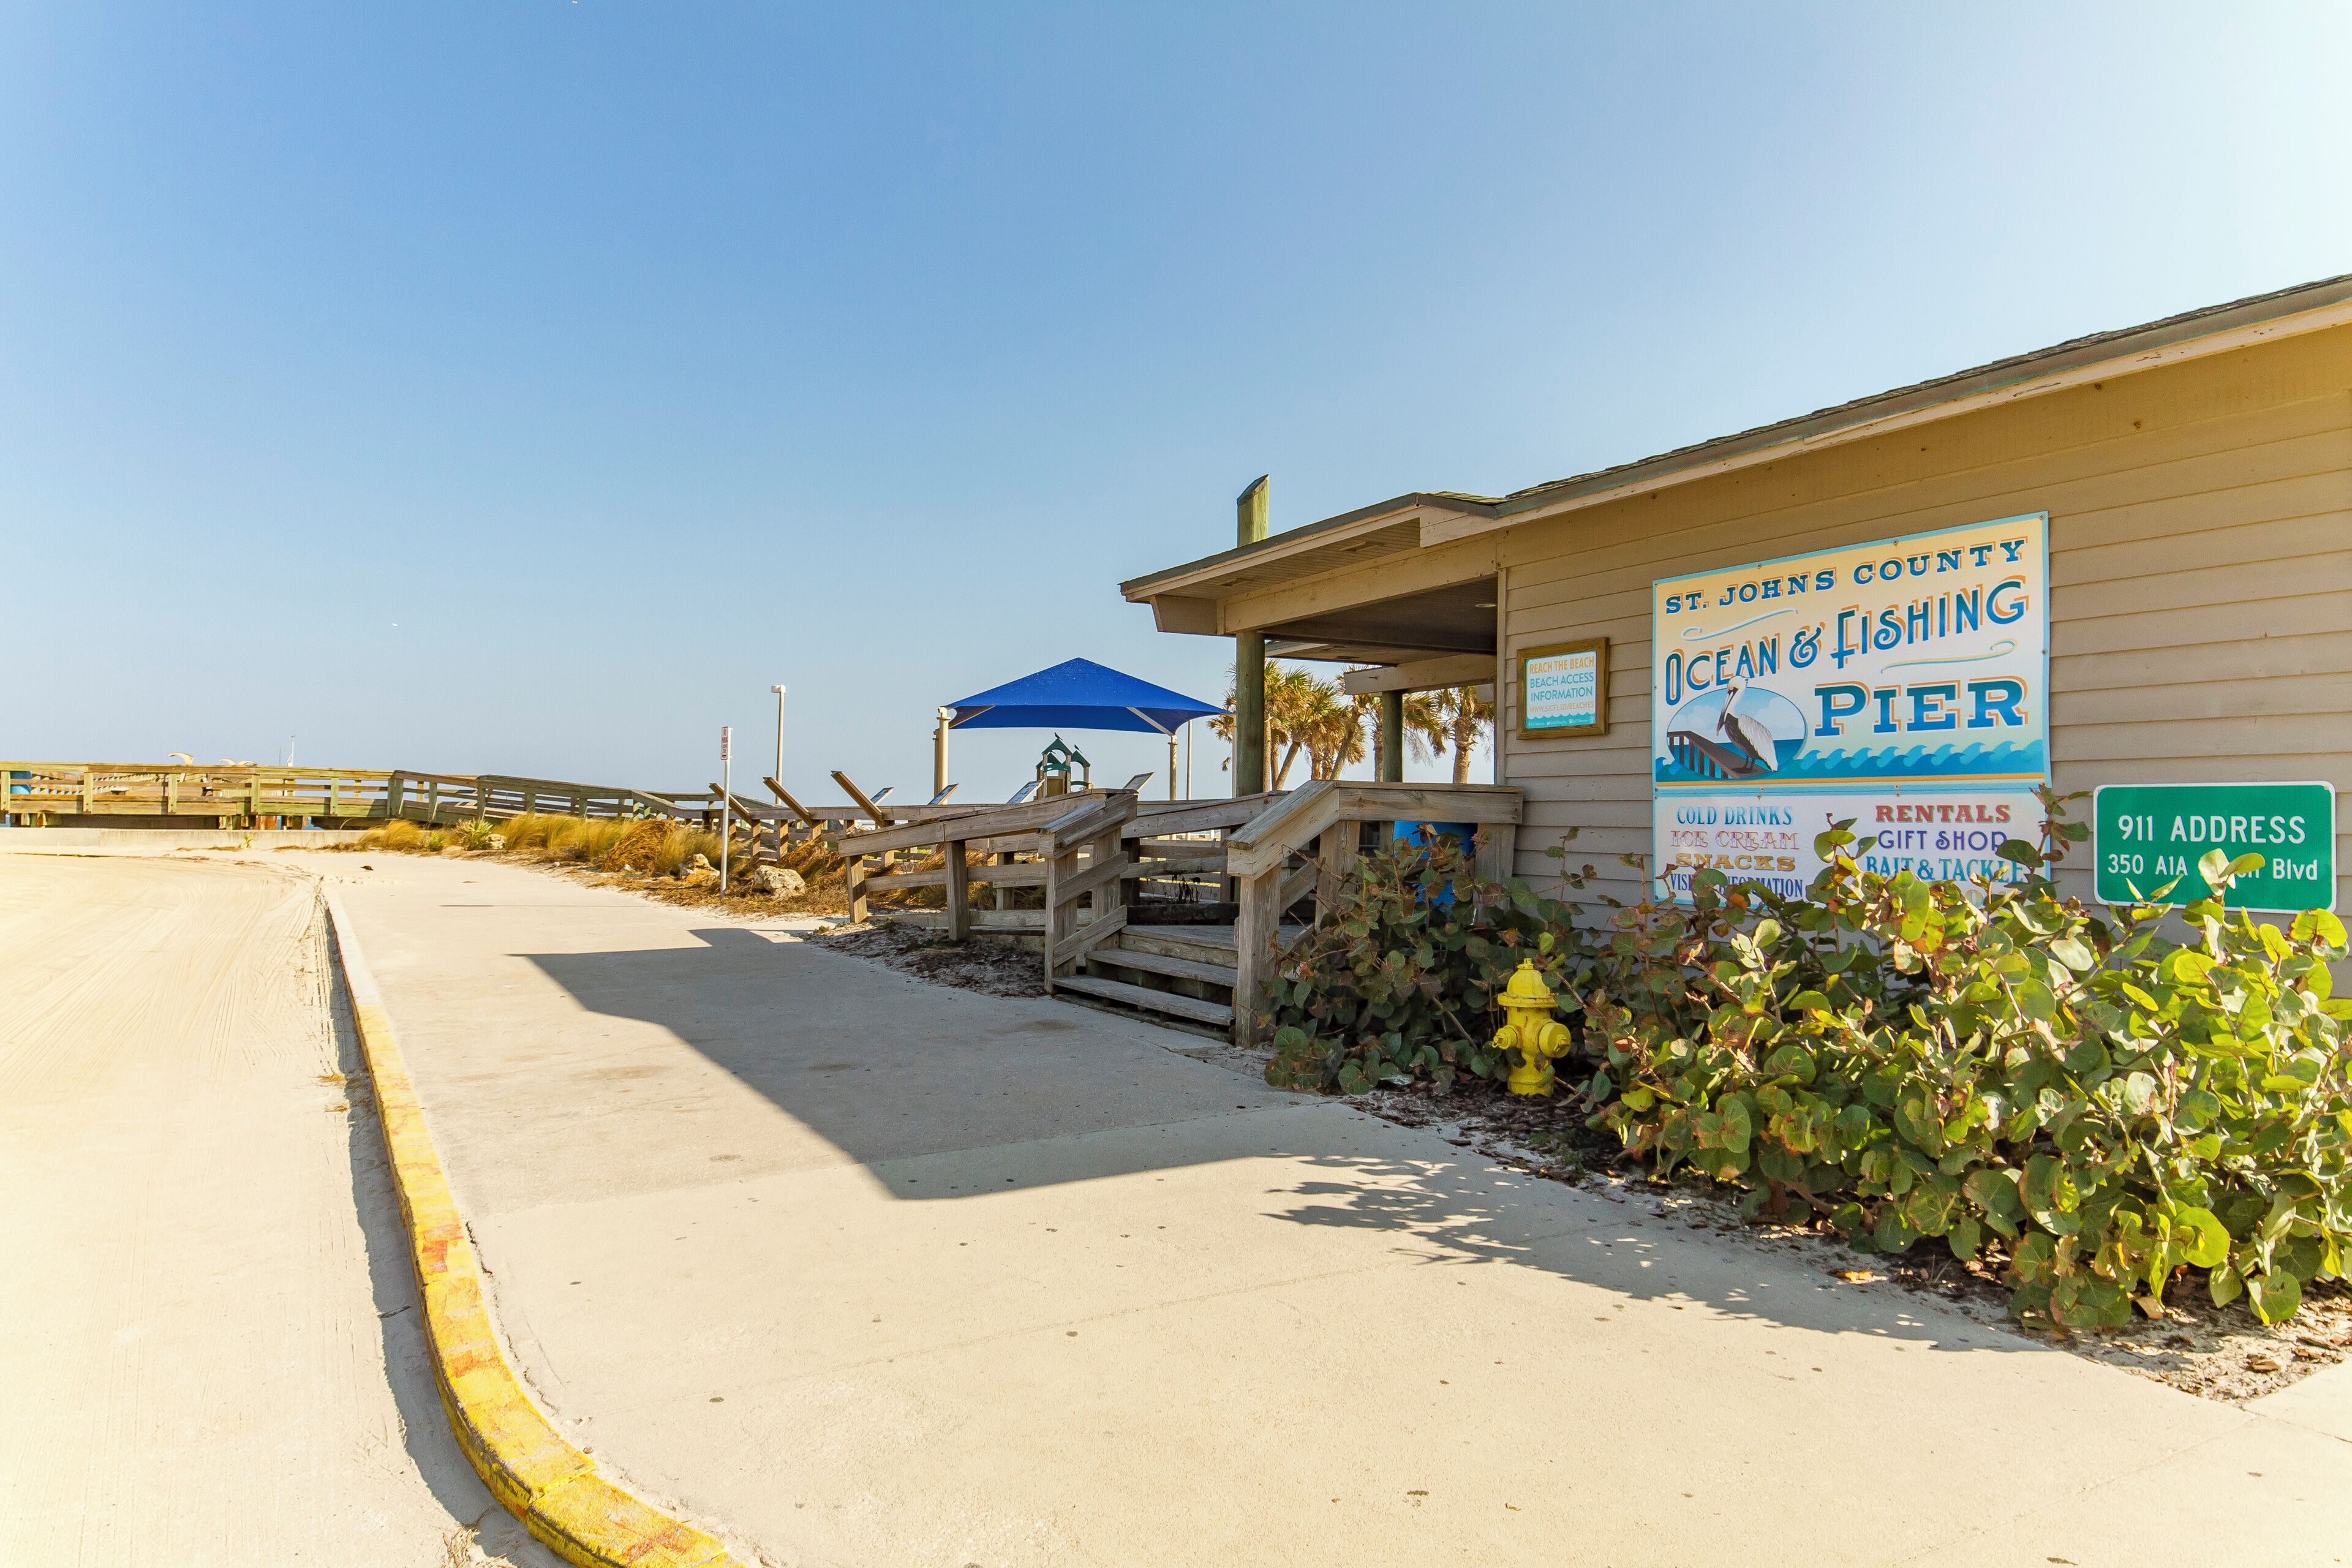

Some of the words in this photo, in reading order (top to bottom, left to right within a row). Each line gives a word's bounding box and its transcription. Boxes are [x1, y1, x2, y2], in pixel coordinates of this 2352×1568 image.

[1666, 589, 1709, 614] ST.
[1719, 567, 1837, 606] JOHNS
[1853, 536, 2029, 584] COUNTY
[1665, 633, 1781, 706] OCEAN
[1789, 622, 1826, 668] &
[1830, 575, 2030, 669] FISHING
[1529, 662, 1553, 674] REACH
[1555, 659, 1568, 671] THE
[1570, 656, 1595, 669] BEACH
[1530, 676, 1559, 688] BEACH
[1560, 672, 1594, 685] ACCESS
[1531, 686, 1593, 702] INFORMATION
[1814, 676, 2029, 736] PIER
[1677, 805, 1717, 824] COLD
[1724, 806, 1793, 825] DRINKS
[1875, 804, 2011, 823] RENTALS
[2118, 815, 2154, 842] 911
[2170, 815, 2305, 844] ADDRESS
[1670, 830, 1708, 848] ICE
[1715, 831, 1800, 851] CREAM
[1878, 830, 1928, 850] GIFT
[1936, 831, 2008, 851] SHOP
[1675, 853, 1796, 872] SNACKS
[1917, 859, 1936, 880] &
[2108, 854, 2144, 875] 350
[2155, 855, 2188, 876] A1A
[2272, 858, 2318, 880] Blvd
